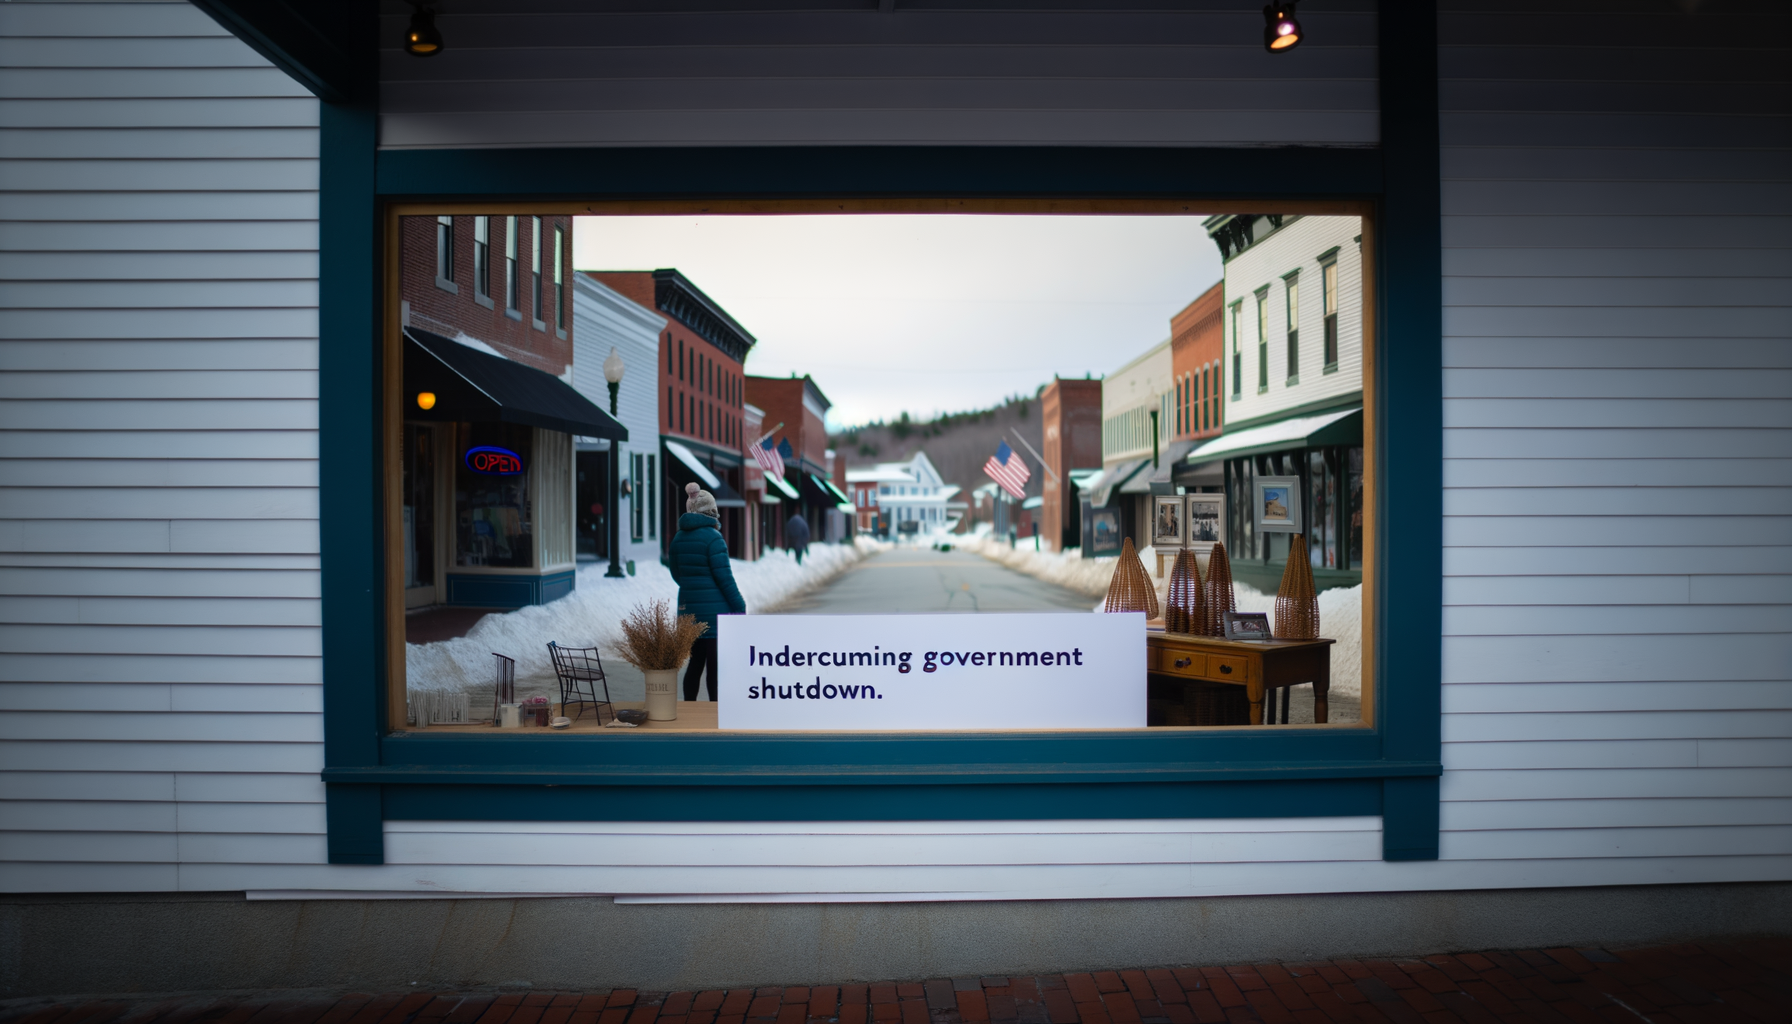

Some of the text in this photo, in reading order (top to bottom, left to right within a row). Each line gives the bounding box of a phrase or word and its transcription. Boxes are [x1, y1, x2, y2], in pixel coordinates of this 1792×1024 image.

[474, 453, 521, 472] OPEN
[923, 647, 1083, 673] government
[748, 676, 883, 699] shutdown.
